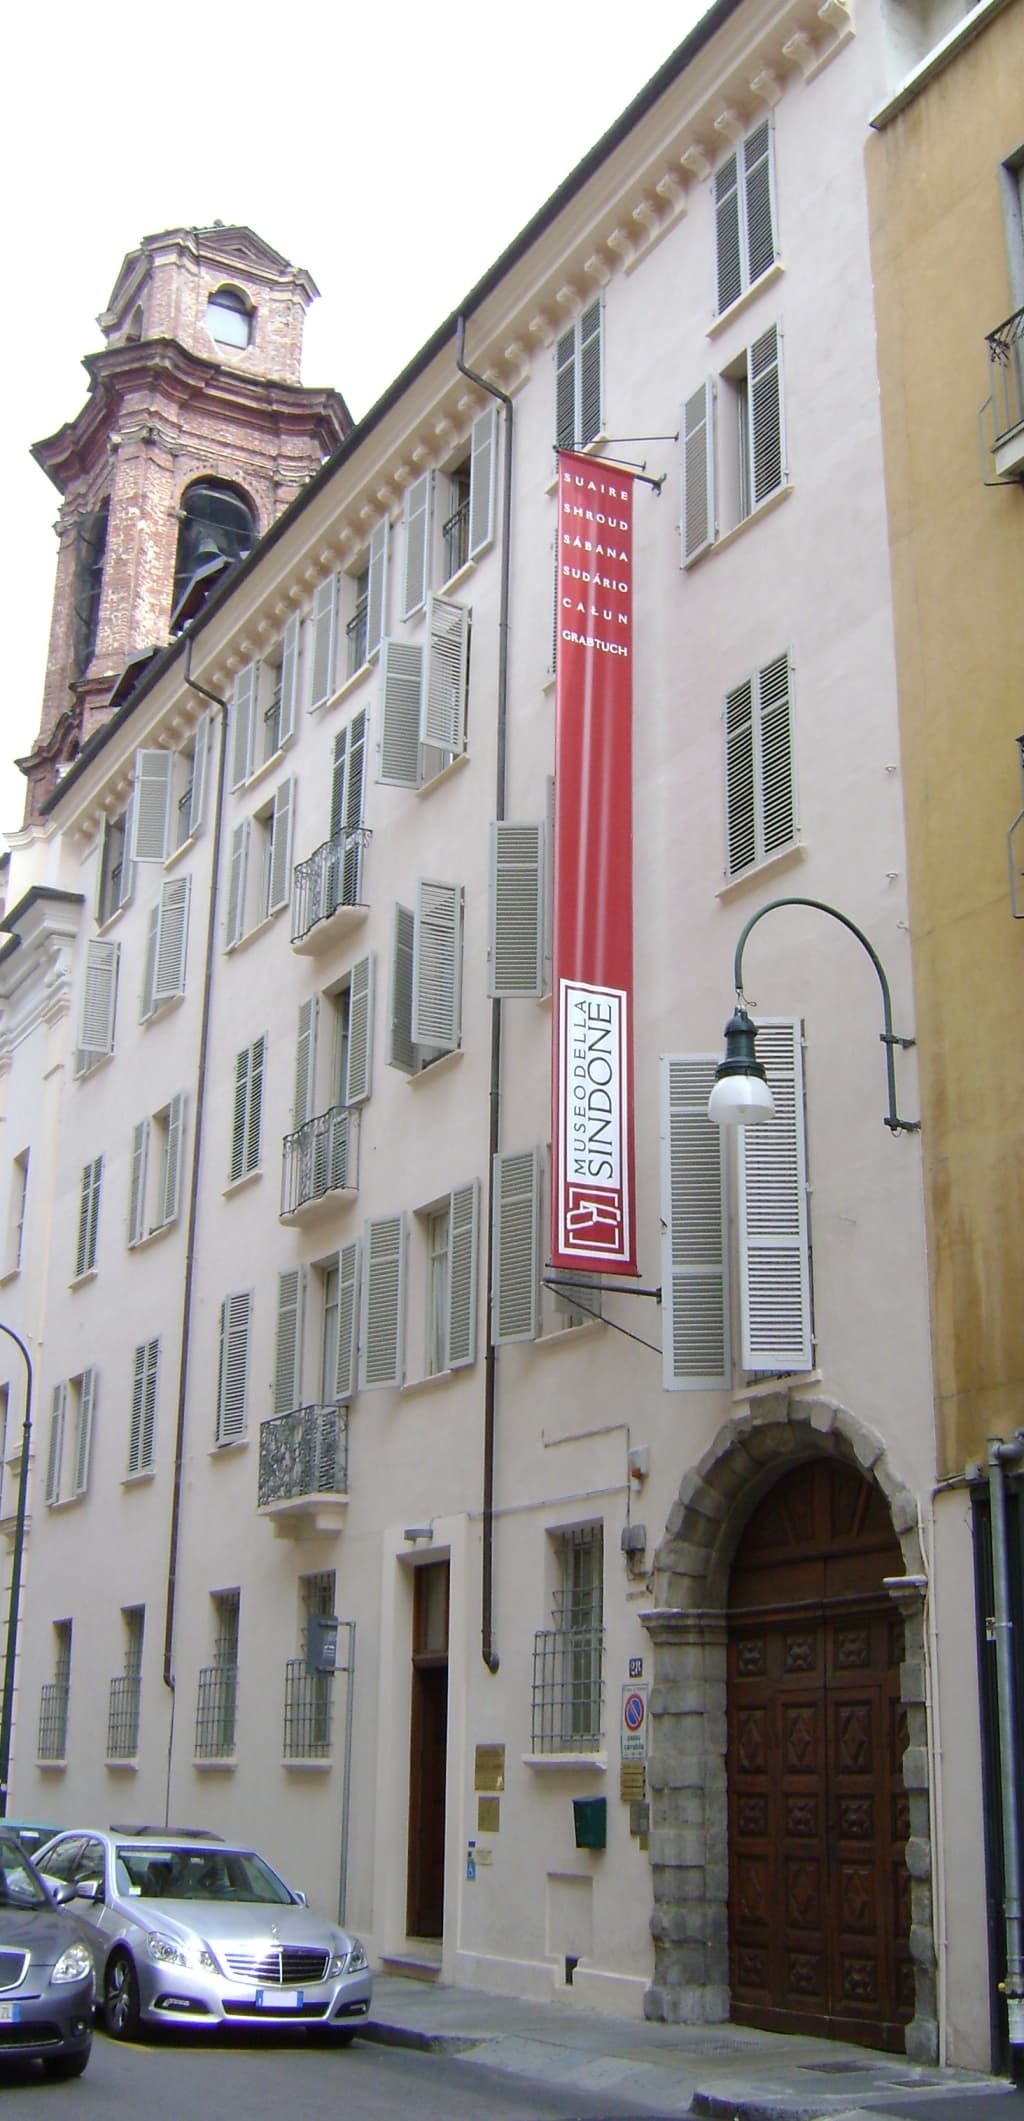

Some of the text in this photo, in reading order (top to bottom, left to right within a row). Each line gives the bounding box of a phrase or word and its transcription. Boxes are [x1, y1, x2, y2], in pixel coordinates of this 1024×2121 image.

[563, 472, 628, 501] SUAIRE
[563, 503, 628, 531] SHROUD
[563, 533, 628, 562] SÁBANA
[562, 565, 628, 593] SUDÁRIO
[562, 629, 628, 657] GRABTUCH
[587, 1001, 613, 1180] SINDONE
